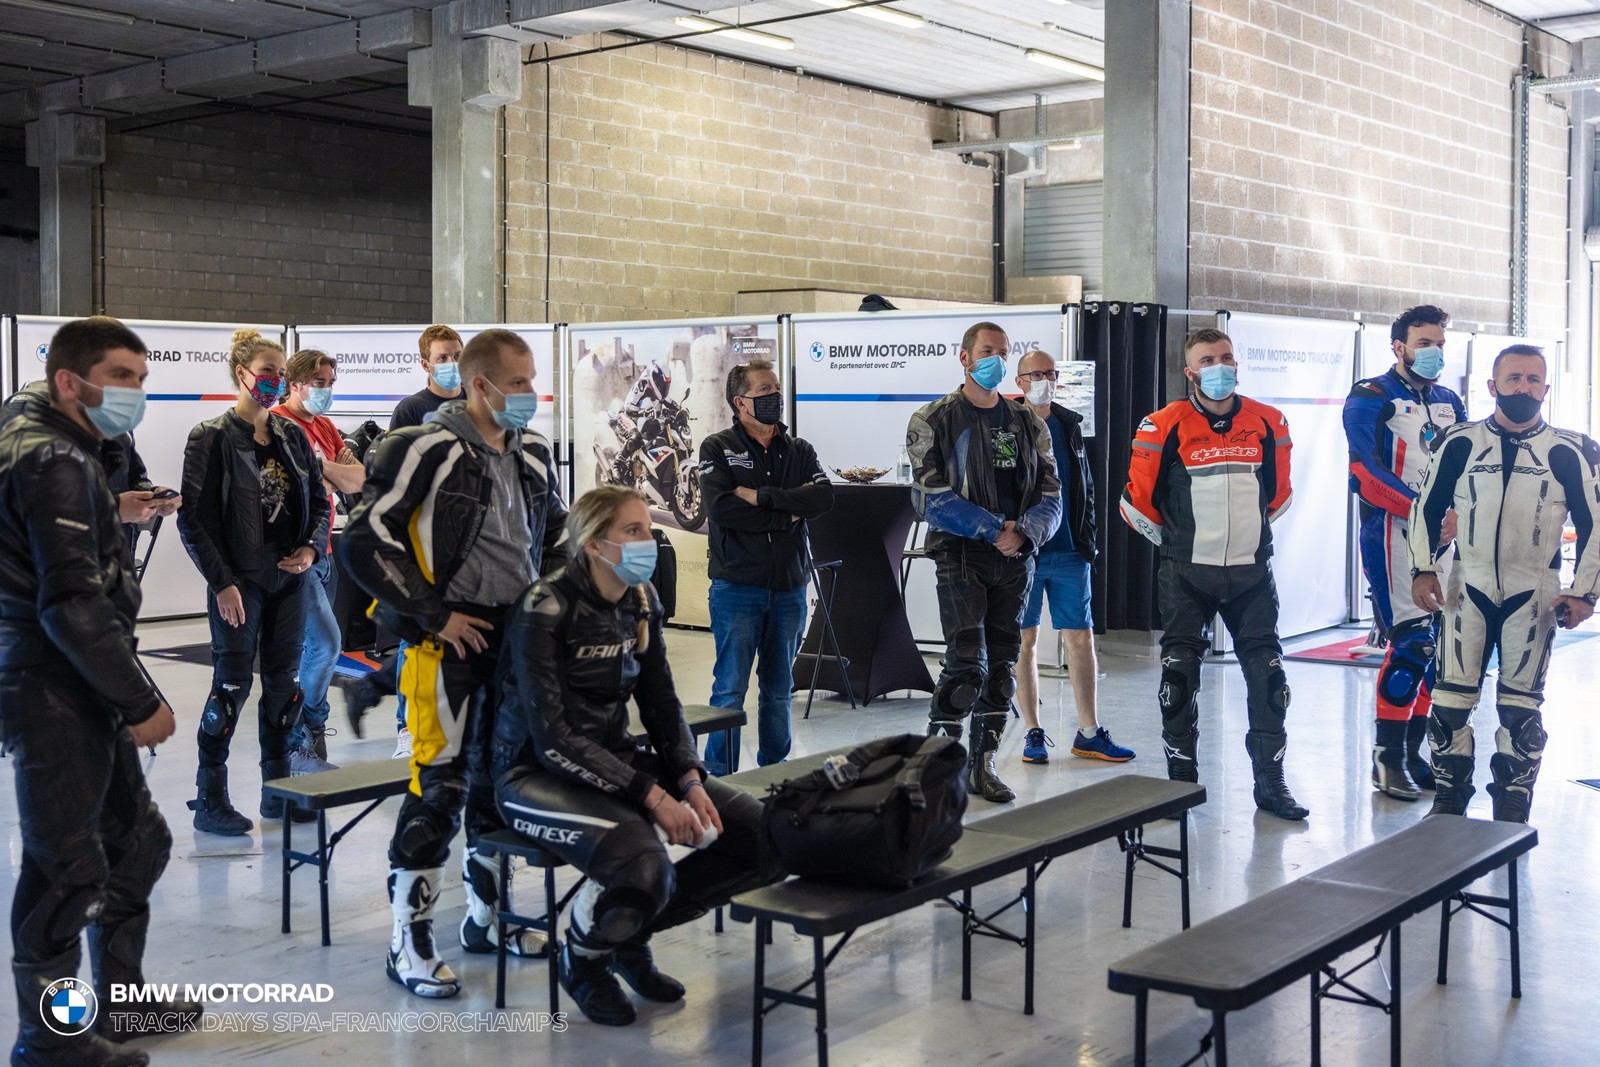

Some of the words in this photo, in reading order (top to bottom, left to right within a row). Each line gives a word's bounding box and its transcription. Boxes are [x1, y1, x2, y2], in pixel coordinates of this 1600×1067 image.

[145, 350, 181, 362] RRAD
[829, 345, 863, 358] BMW
[866, 343, 947, 358] MOTORRAD
[1248, 348, 1266, 361] BMW
[1268, 349, 1306, 363] MOTORRAD
[1308, 351, 1329, 365] TRACK
[336, 353, 369, 364] BMW
[374, 353, 421, 364] MOTOR
[830, 361, 838, 369] En
[838, 361, 873, 370] partenariat
[345, 367, 381, 375] partenariat
[1190, 446, 1258, 462] alpinestars
[544, 748, 621, 793] DAINESE
[513, 818, 584, 845] DAINESE
